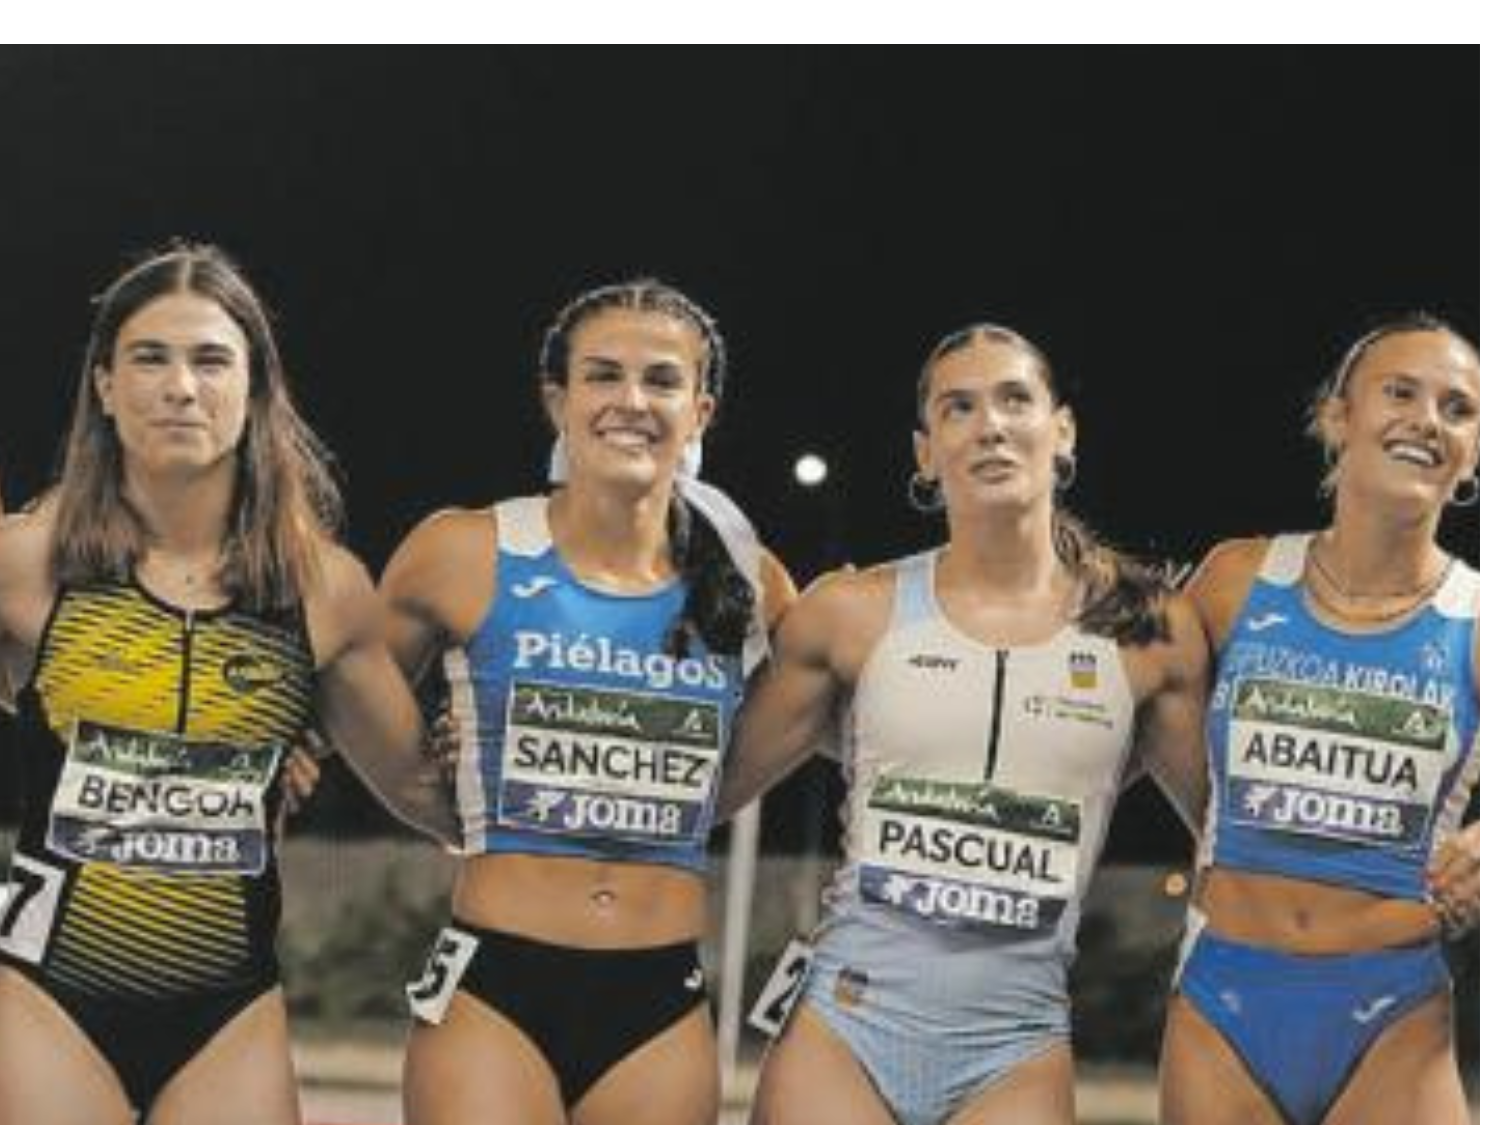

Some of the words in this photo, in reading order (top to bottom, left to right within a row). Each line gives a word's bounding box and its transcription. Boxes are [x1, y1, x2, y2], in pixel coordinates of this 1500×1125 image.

[513, 631, 727, 689] Piélagos
[514, 737, 708, 788] SANCHEZ
[1244, 732, 1418, 790] ABAITUA
[77, 774, 254, 816] BENGOA
[879, 819, 1061, 883] PASCUAL
[0, 865, 47, 937] 7
[408, 937, 460, 1000] 5
[765, 955, 811, 1022] 2
